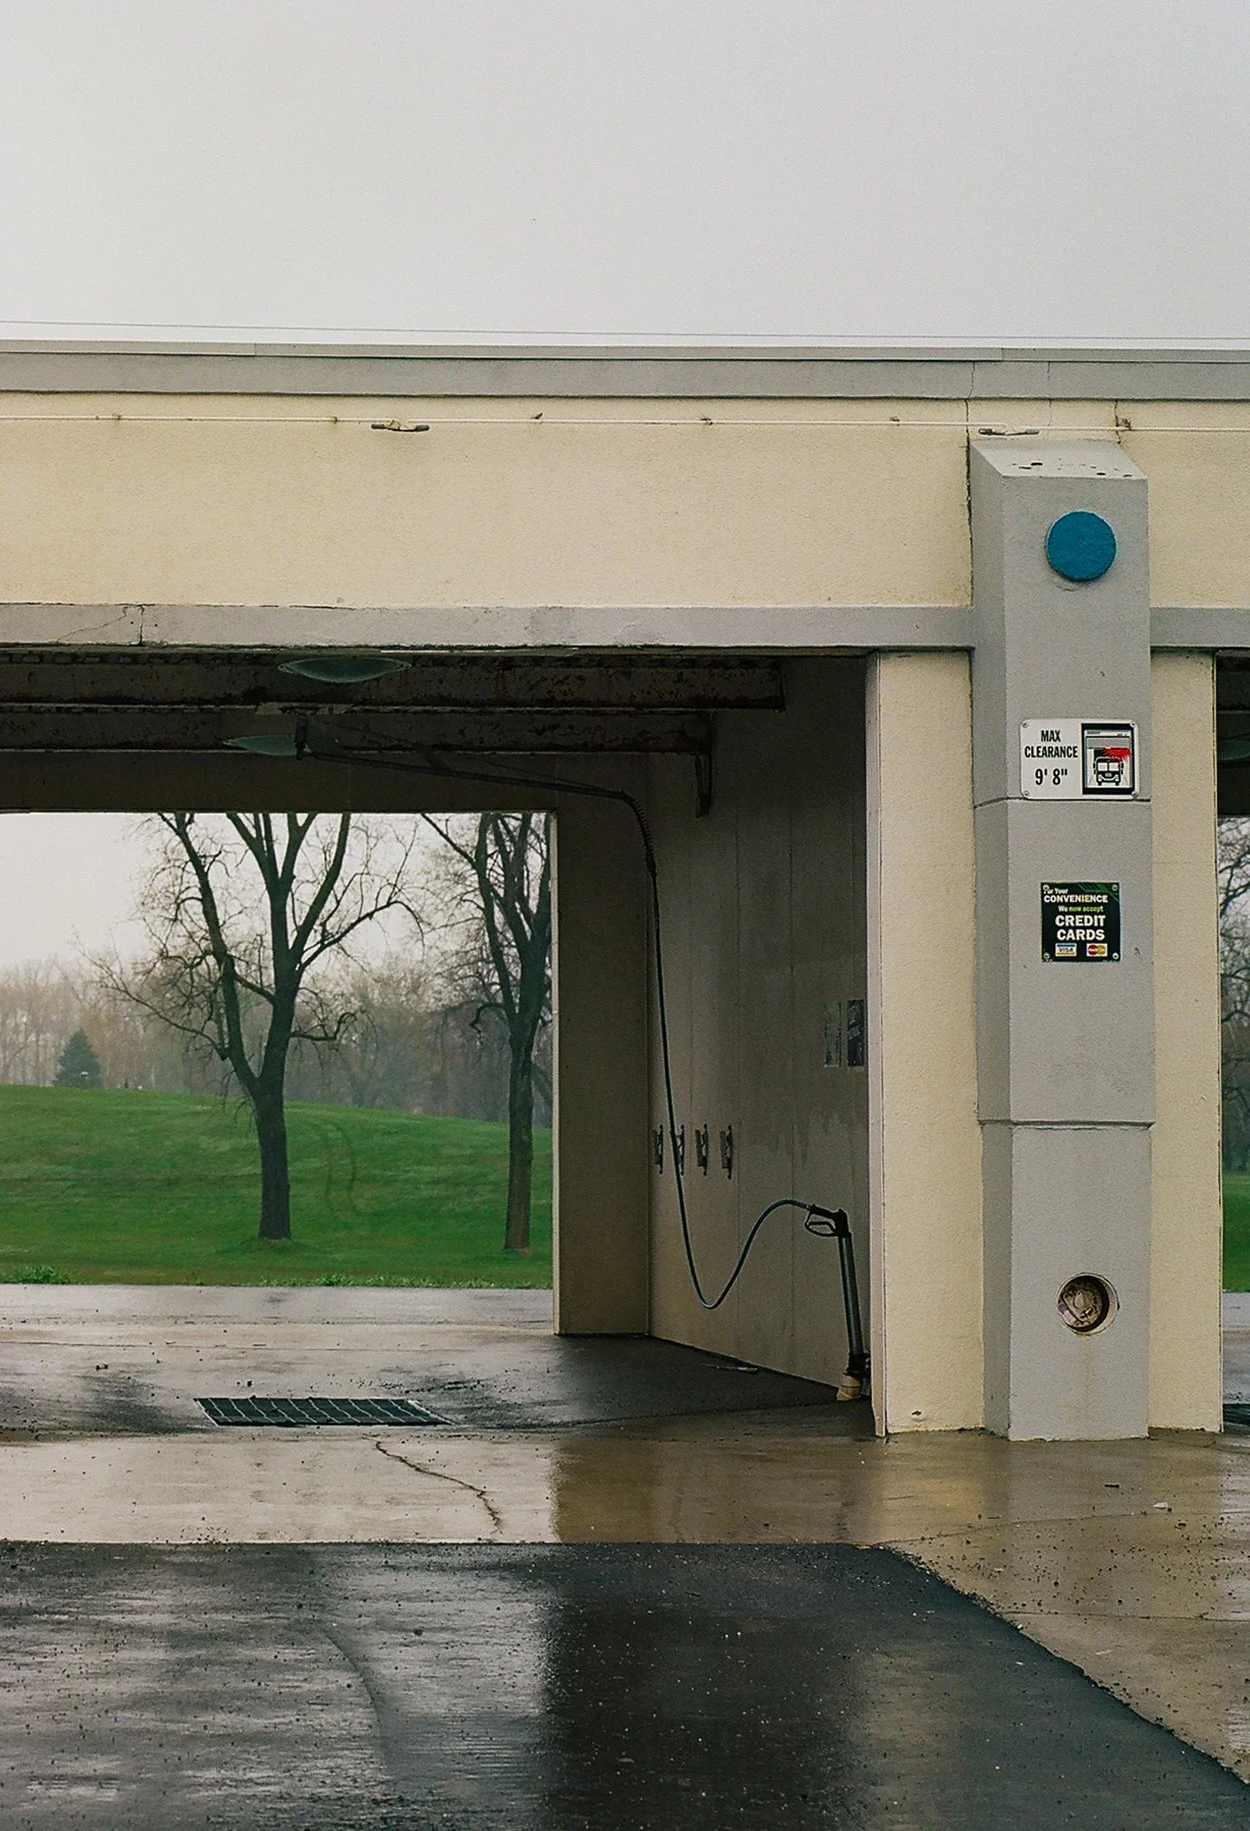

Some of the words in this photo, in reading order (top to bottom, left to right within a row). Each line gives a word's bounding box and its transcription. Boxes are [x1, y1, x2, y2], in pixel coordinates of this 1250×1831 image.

[1040, 730, 1061, 742] MAX
[1024, 746, 1079, 758] CLEARANCE
[1043, 895, 1108, 903] CONVENIENCE
[1082, 905, 1104, 913] accept
[1055, 915, 1106, 927] CREDIT
[1056, 929, 1105, 941] CARDS
